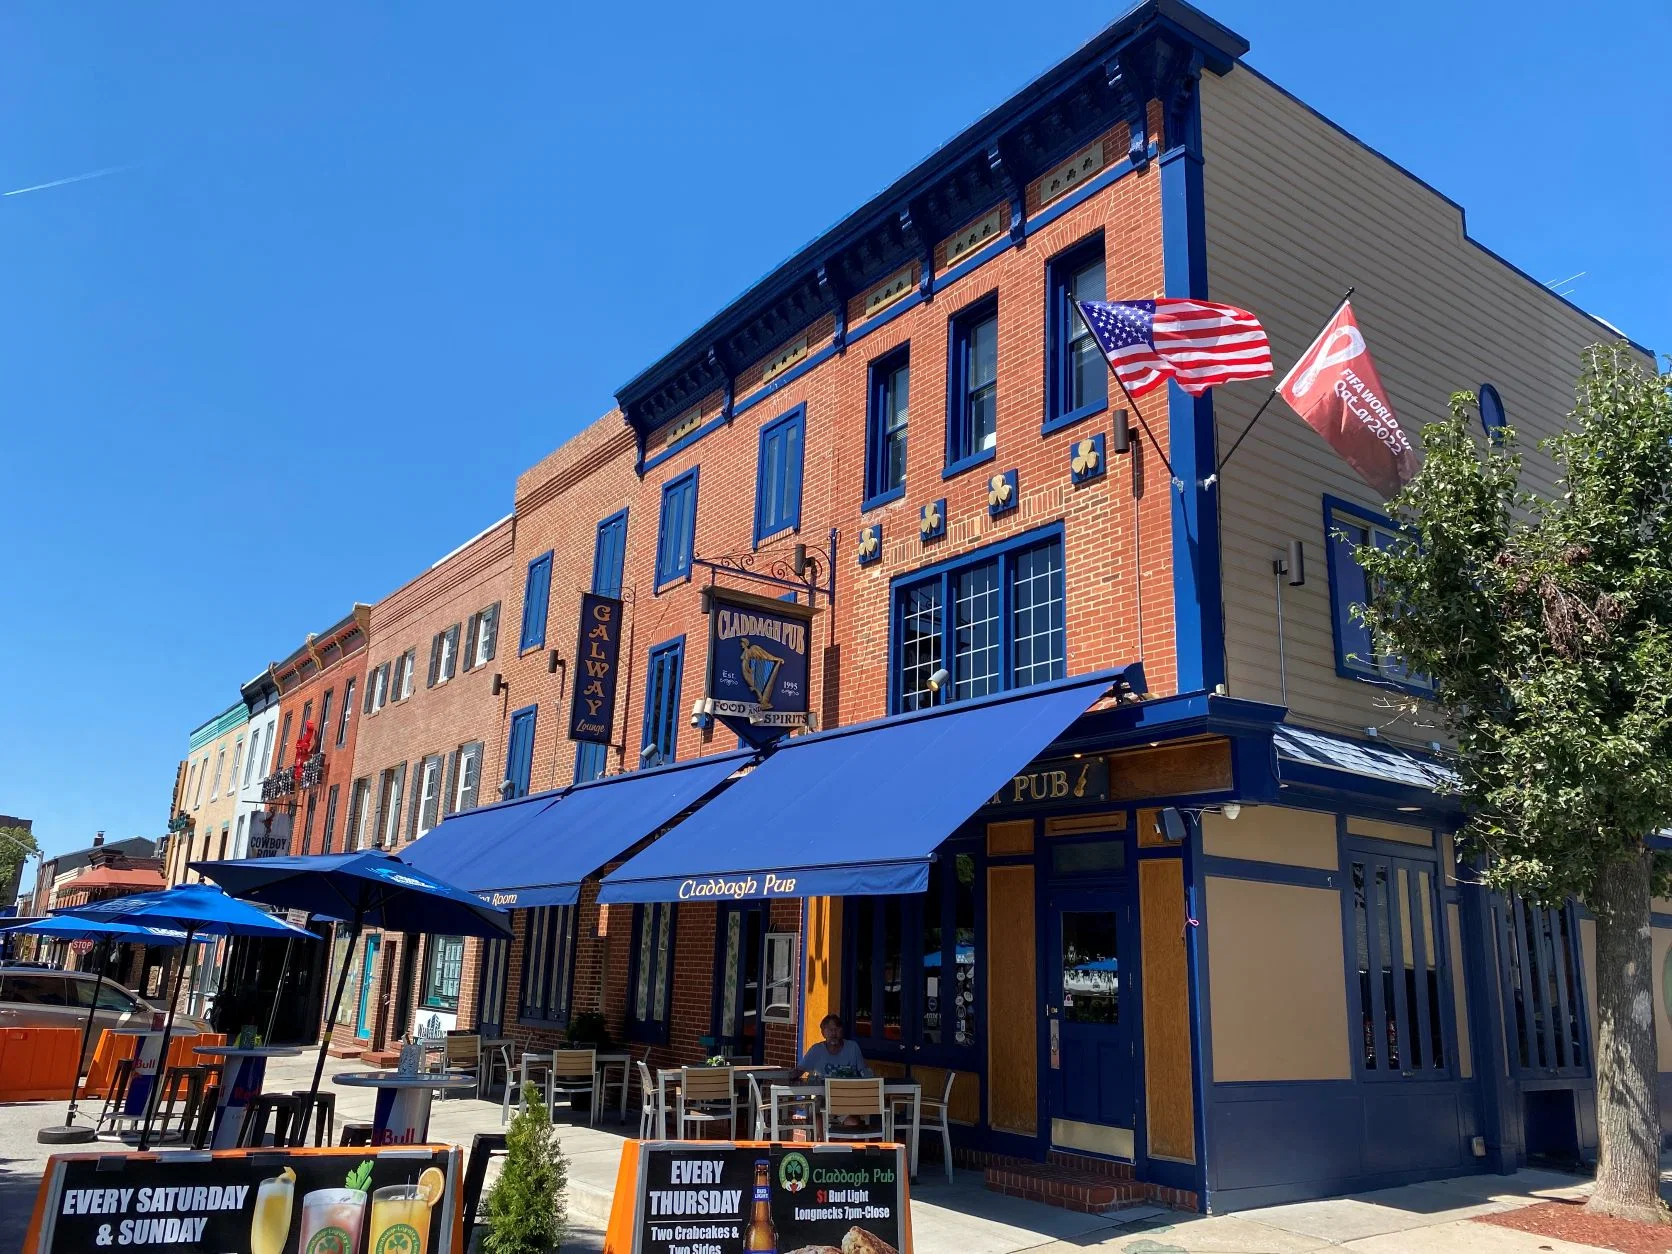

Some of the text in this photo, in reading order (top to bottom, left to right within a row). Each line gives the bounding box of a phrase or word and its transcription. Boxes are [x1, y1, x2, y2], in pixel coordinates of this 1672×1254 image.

[1340, 368, 1364, 393] FIFA
[1361, 388, 1399, 428] WORLD
[717, 610, 805, 655] CLADDAGH PUB
[583, 605, 611, 716] GALWAY
[783, 681, 798, 690] 1995
[713, 701, 746, 713] FOOD
[576, 719, 605, 736] Lounge
[1012, 770, 1069, 802] PUB
[250, 836, 287, 850] COWBOY
[679, 877, 757, 899] Claddagh
[491, 893, 518, 907] Room
[73, 940, 92, 950] STOP
[383, 1128, 415, 1145] Bull
[671, 1160, 725, 1184] EVERY
[812, 1168, 869, 1186] Claddagh
[873, 1168, 895, 1183] Pub
[63, 1185, 249, 1215] EVERY SATURDAY
[649, 1190, 743, 1215] THURSDAY
[828, 1190, 846, 1203] Bud
[847, 1189, 869, 1204] Light
[795, 1206, 890, 1221] Longnecks 7pm-Close
[96, 1217, 208, 1245] & SUNDAY
[651, 1225, 740, 1240] Two Crabcakes &
[669, 1243, 722, 1254] Two Sides
